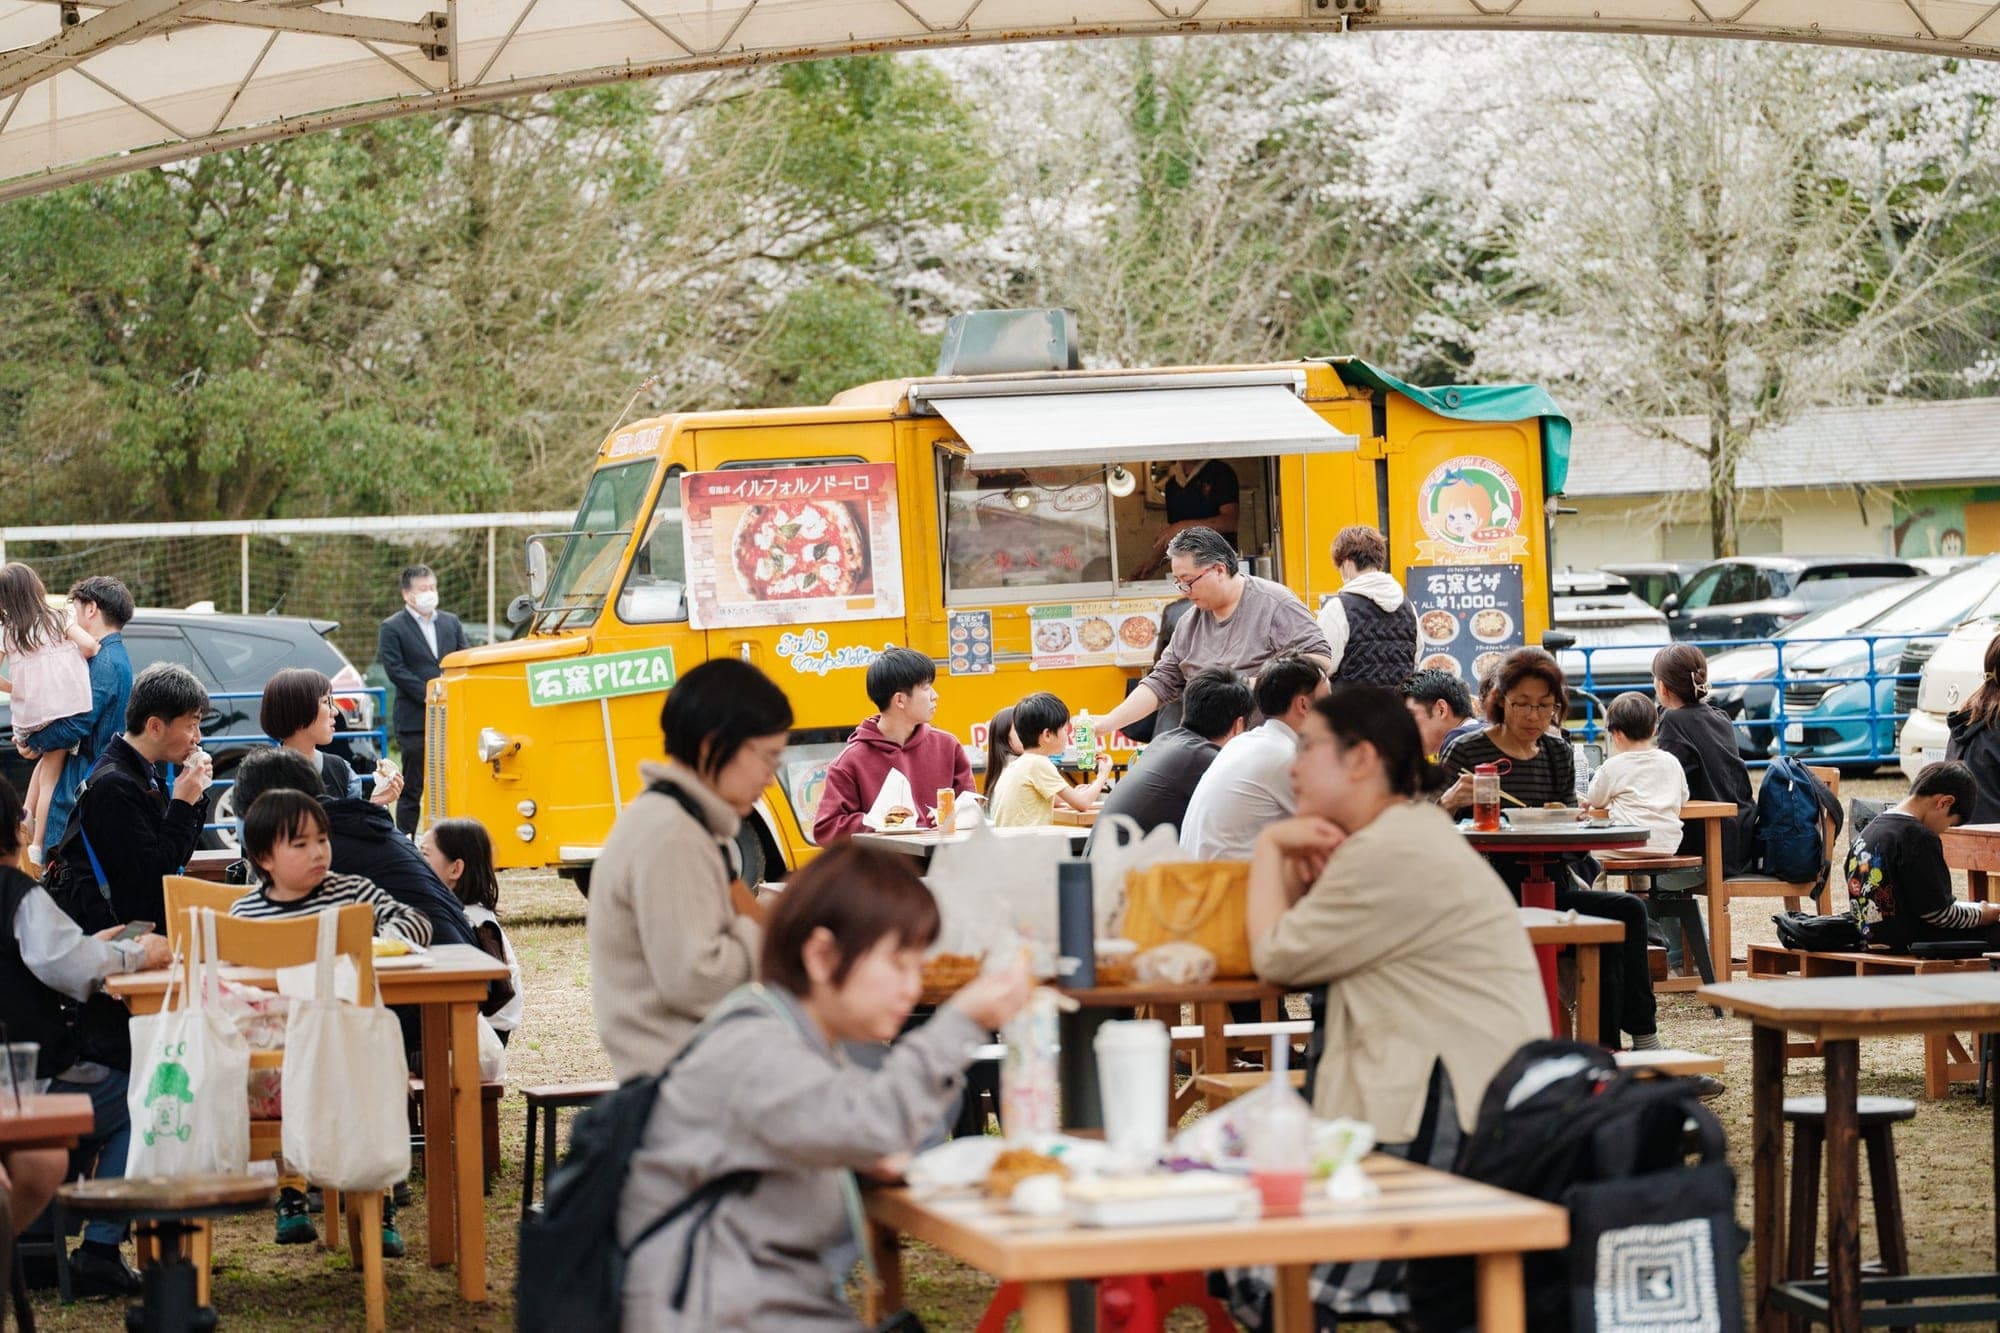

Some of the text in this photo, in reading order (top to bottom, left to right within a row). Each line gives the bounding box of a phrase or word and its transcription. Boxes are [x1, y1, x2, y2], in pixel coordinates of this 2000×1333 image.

[732, 475, 870, 498] イルフォルノドーロ
[1427, 572, 1501, 594] 石窯ピザ
[1436, 594, 1496, 610] ¥1,000
